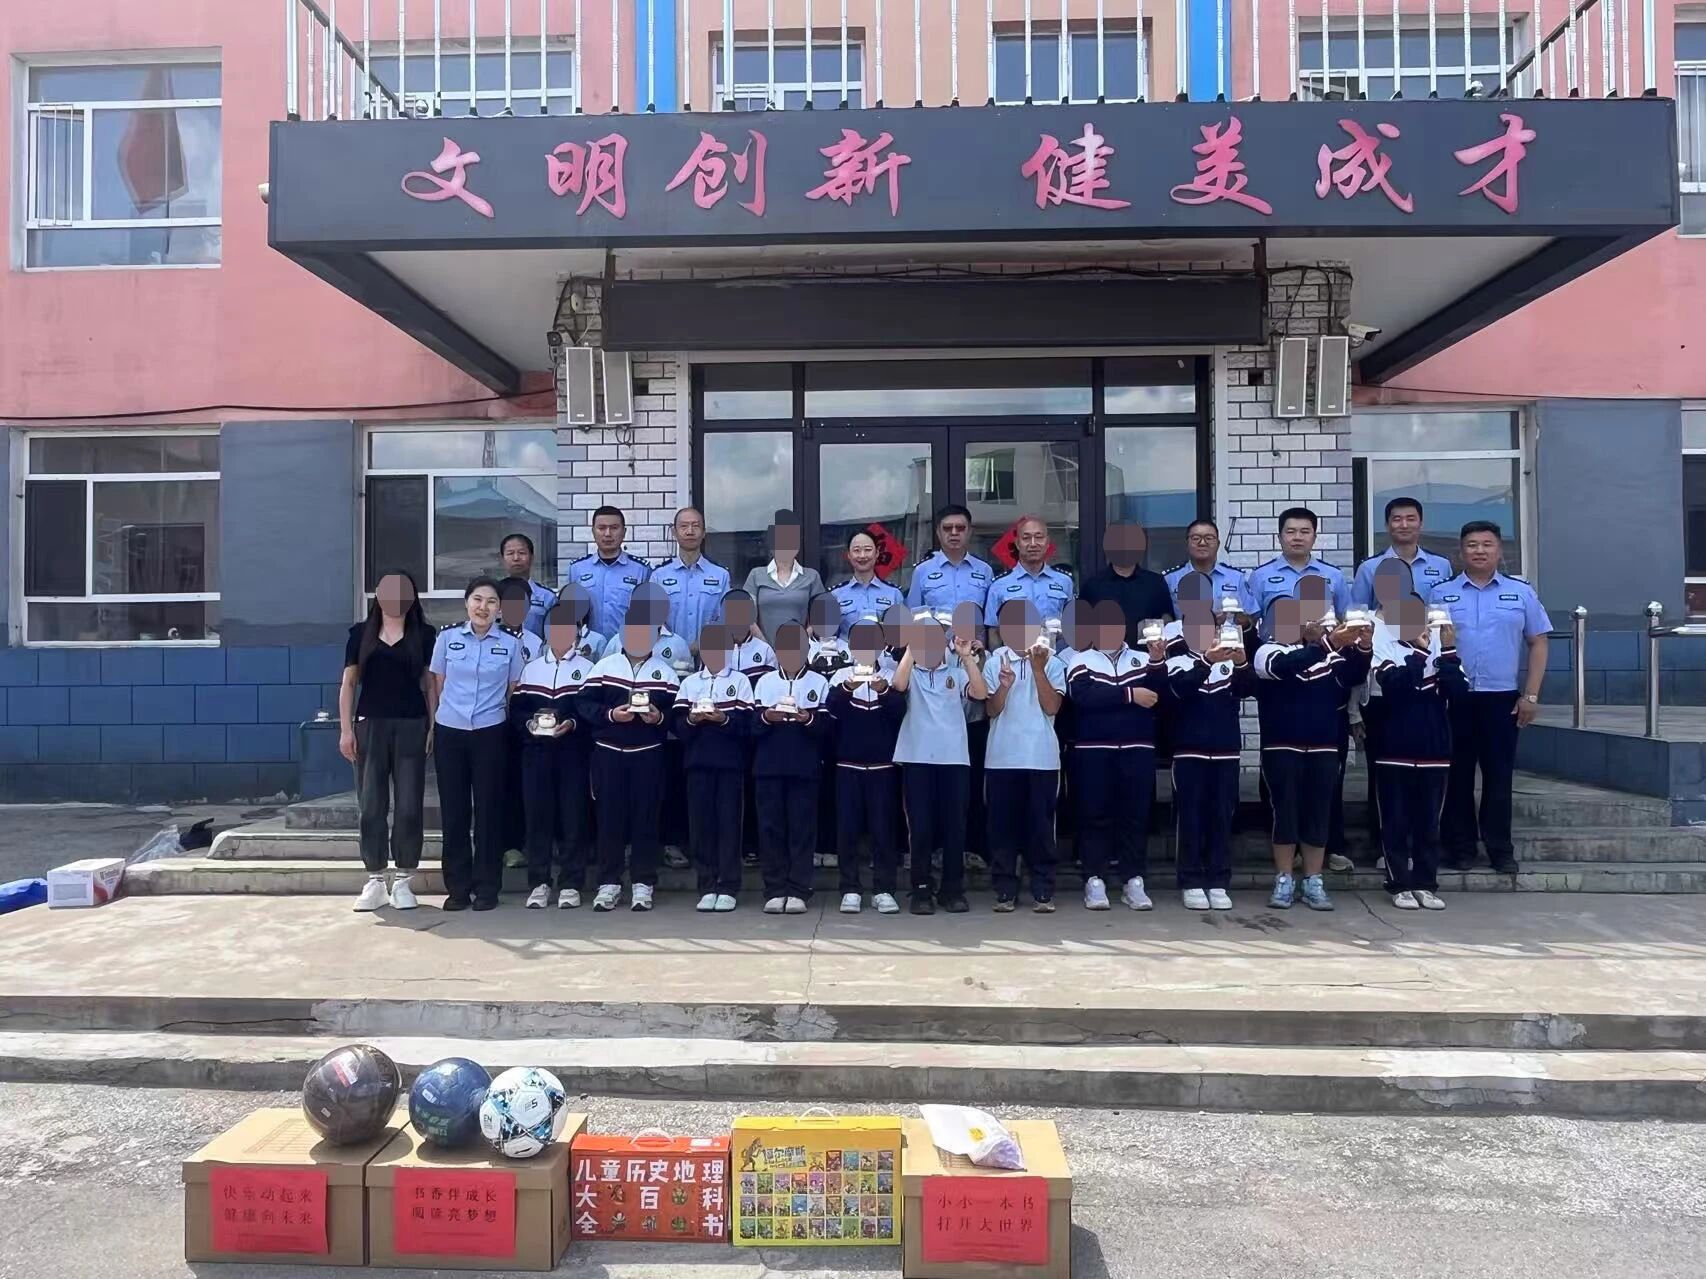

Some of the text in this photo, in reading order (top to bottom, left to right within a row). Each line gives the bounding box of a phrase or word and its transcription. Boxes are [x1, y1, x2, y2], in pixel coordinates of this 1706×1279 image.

[401, 113, 1537, 219] 文明创新 健美成才
[575, 1158, 724, 1184] 儿童历史地理
[575, 1184, 724, 1211] 大 百 科
[937, 1192, 1034, 1211] 小小一本书
[575, 1211, 724, 1237] 全 书
[937, 1216, 1034, 1233] 打开大世界
